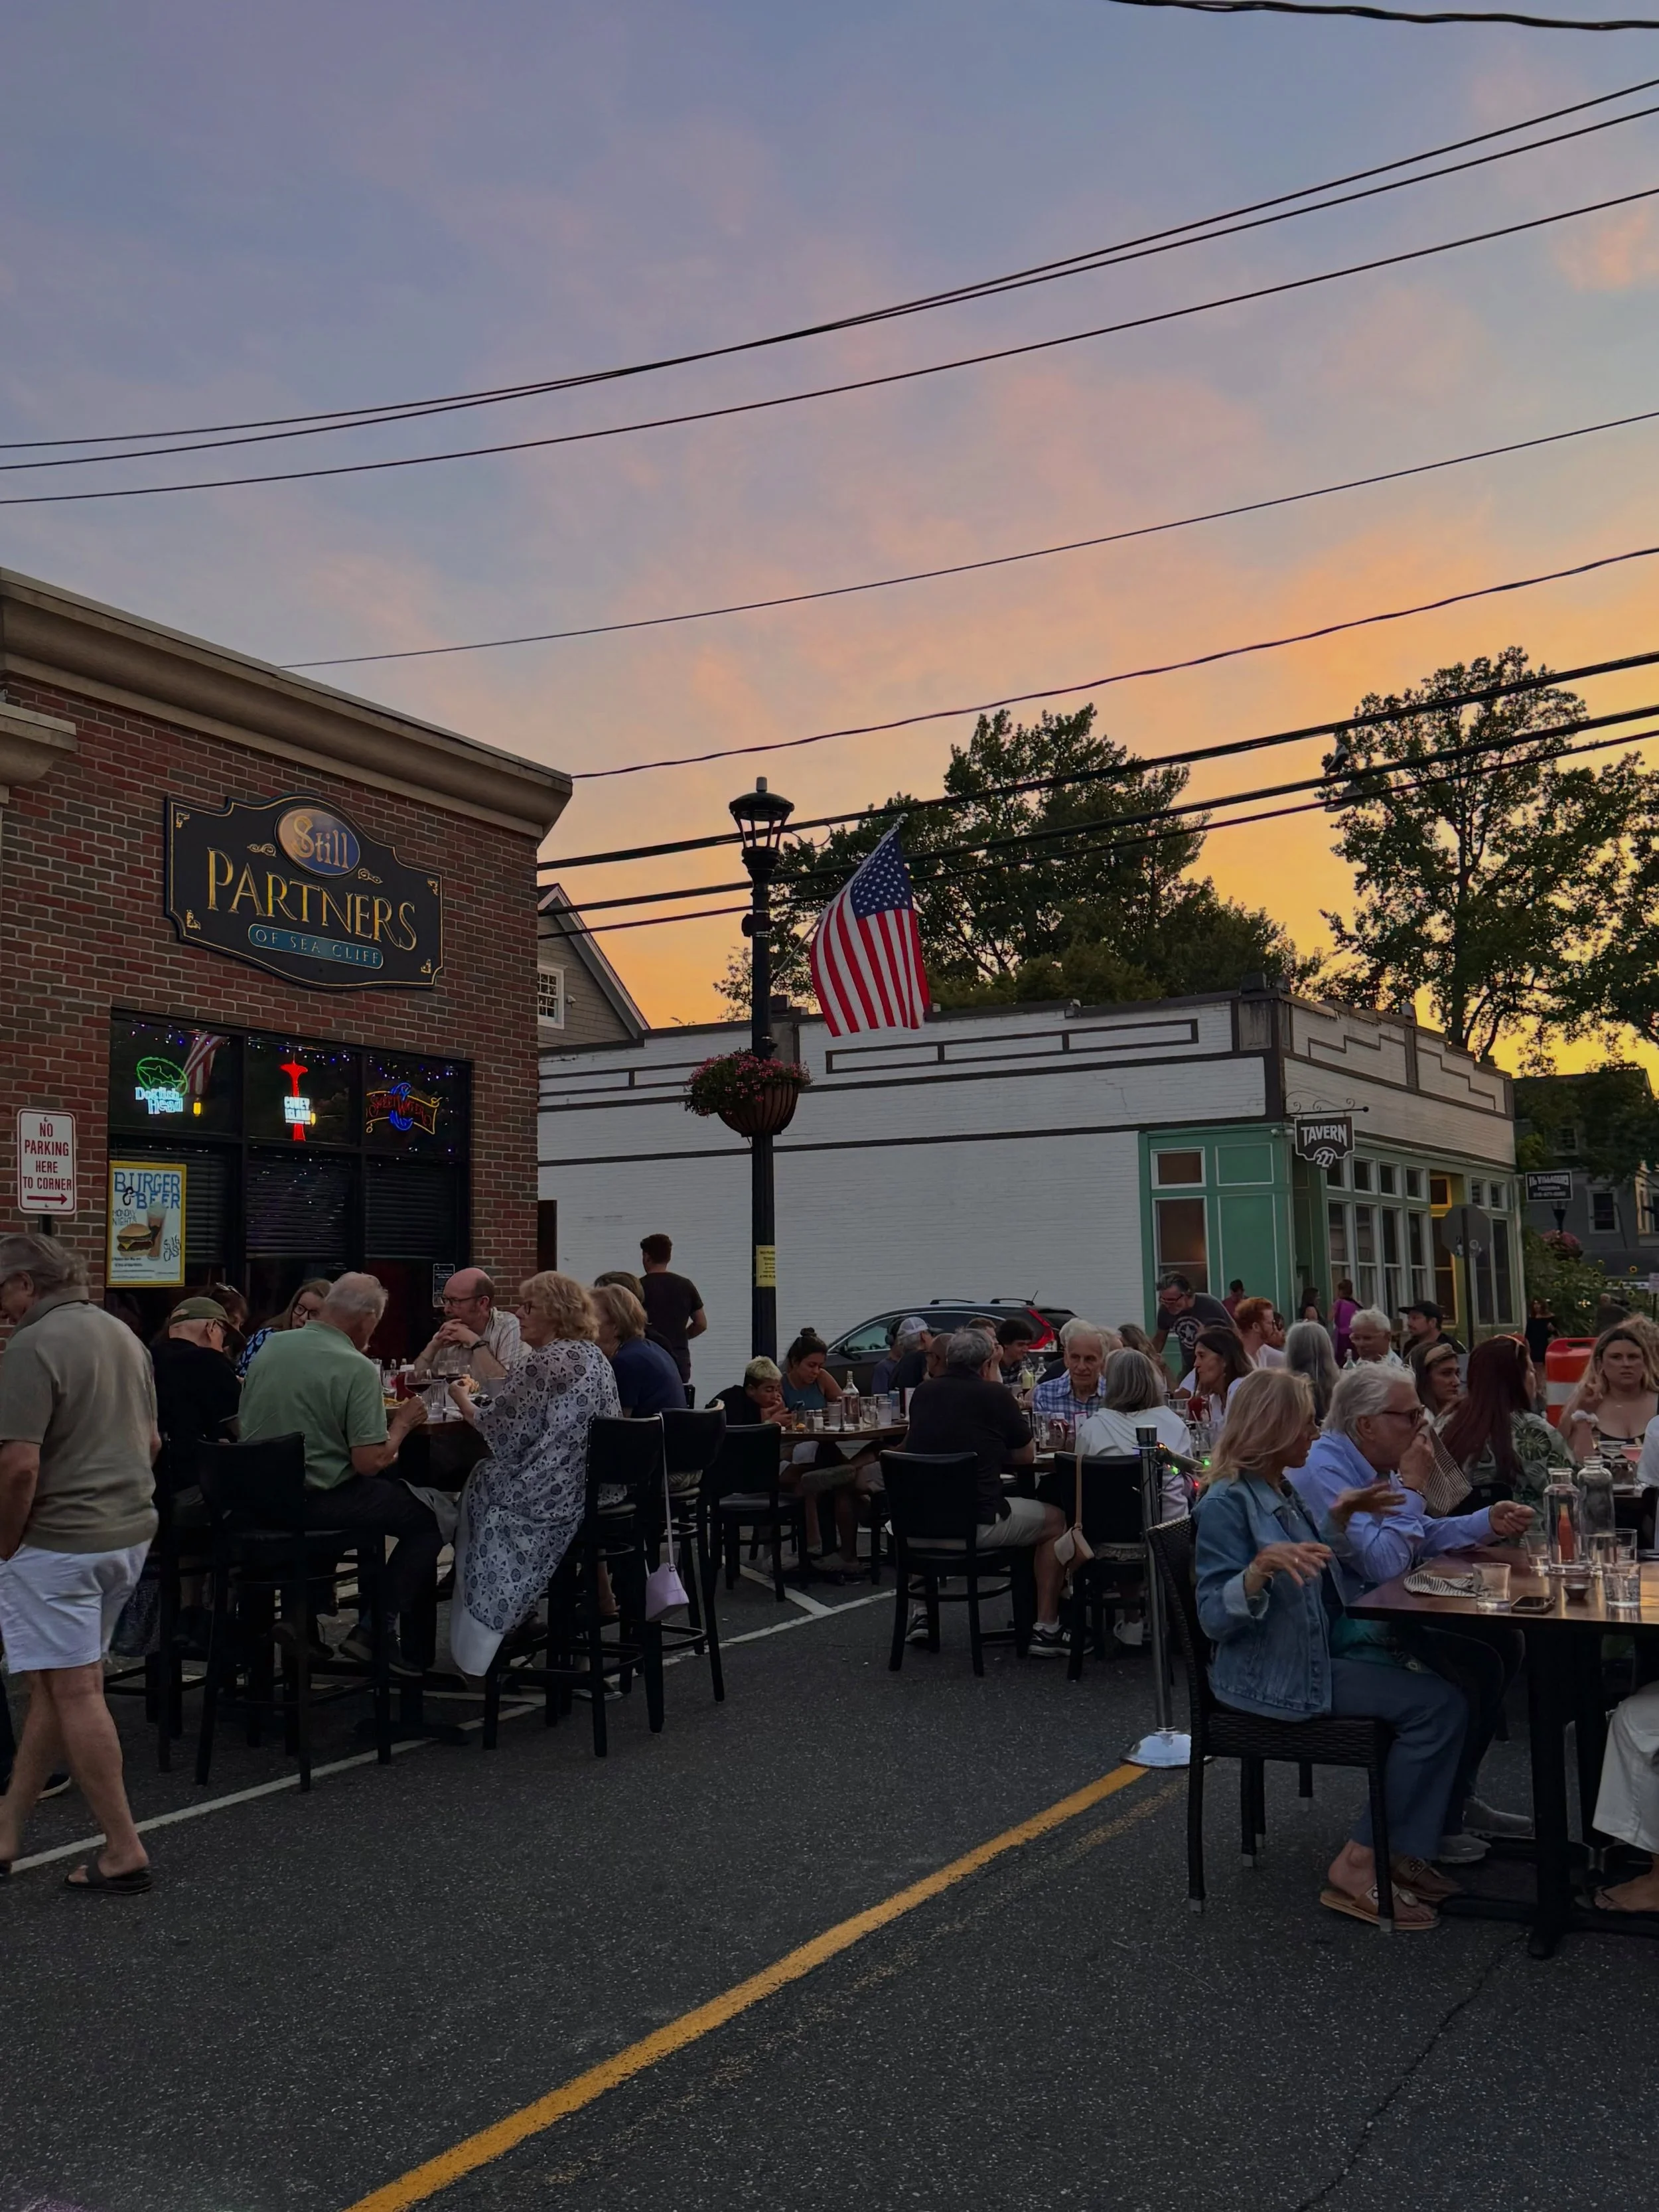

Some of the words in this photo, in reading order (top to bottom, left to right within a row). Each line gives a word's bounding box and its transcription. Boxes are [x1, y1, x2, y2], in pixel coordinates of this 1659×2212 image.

[292, 815, 350, 869] Still
[206, 846, 417, 952] PARTNERS
[255, 929, 279, 944] OF
[290, 936, 321, 953] SEA
[332, 944, 380, 964] CLIFF
[147, 1097, 184, 1115] Head
[39, 1122, 53, 1138] NO
[1301, 1124, 1348, 1147] TAVERN
[25, 1139, 69, 1156] PARKING
[35, 1160, 58, 1174] HERE
[1316, 1150, 1334, 1168] 227
[23, 1176, 33, 1189] TO
[37, 1177, 72, 1191] CORNER
[113, 1171, 180, 1194] BURGER
[122, 1186, 136, 1206] &
[136, 1193, 180, 1209] BEER
